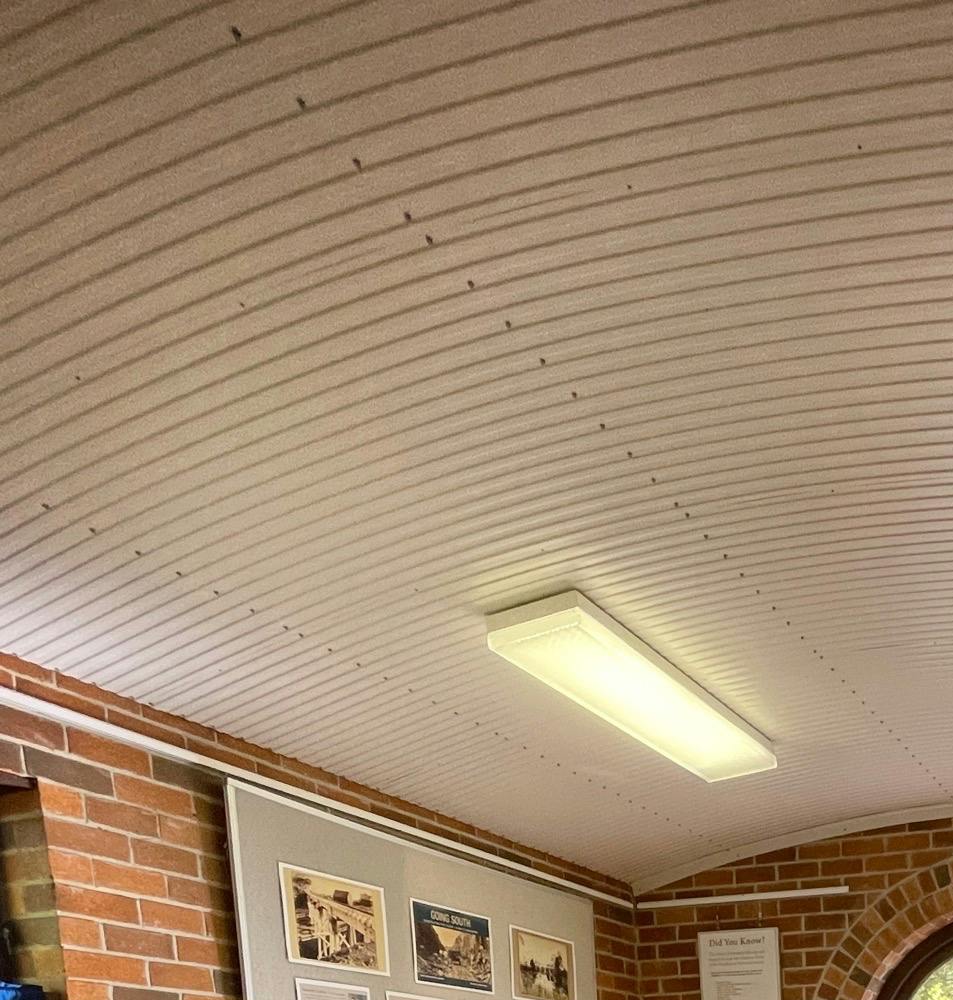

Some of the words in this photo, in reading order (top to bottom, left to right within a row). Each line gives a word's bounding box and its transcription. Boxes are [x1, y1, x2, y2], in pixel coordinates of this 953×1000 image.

[450, 915, 472, 928] SOUTH
[708, 938, 722, 947] Did
[724, 937, 738, 946] You
[740, 936, 766, 946] Know?
